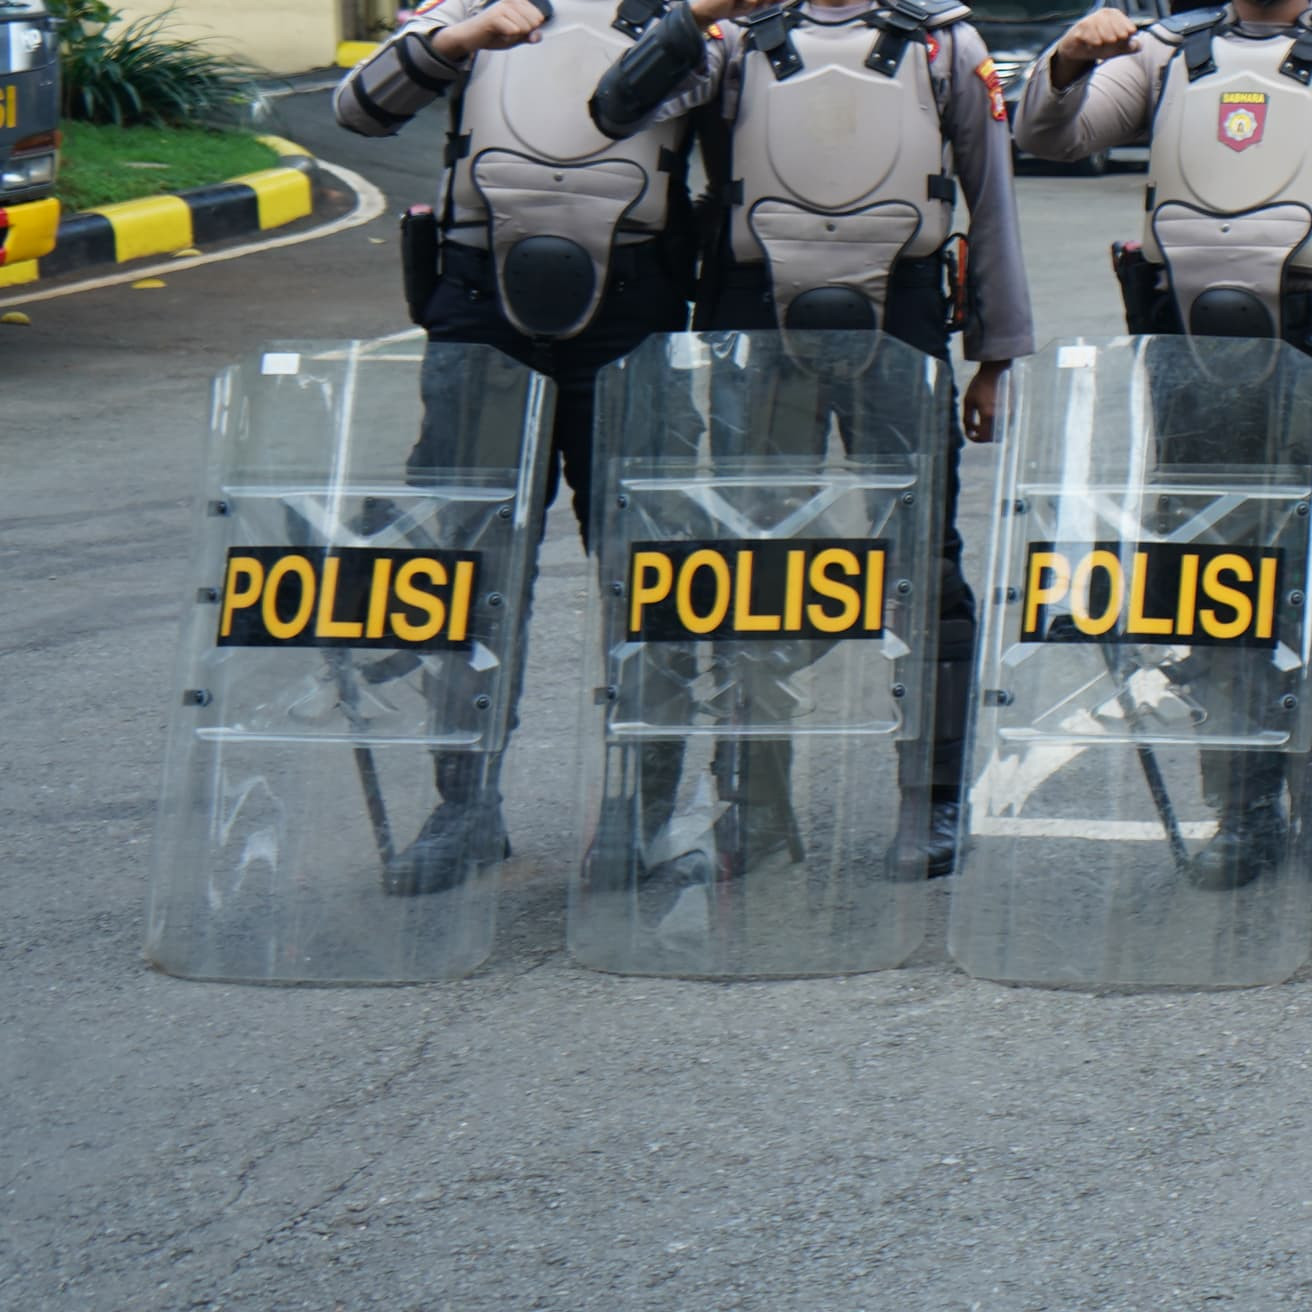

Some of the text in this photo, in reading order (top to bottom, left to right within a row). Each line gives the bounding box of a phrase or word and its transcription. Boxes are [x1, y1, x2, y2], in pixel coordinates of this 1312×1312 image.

[220, 554, 474, 641] POLISI
[628, 547, 886, 634] POLISI
[1024, 550, 1278, 639] POLISI
